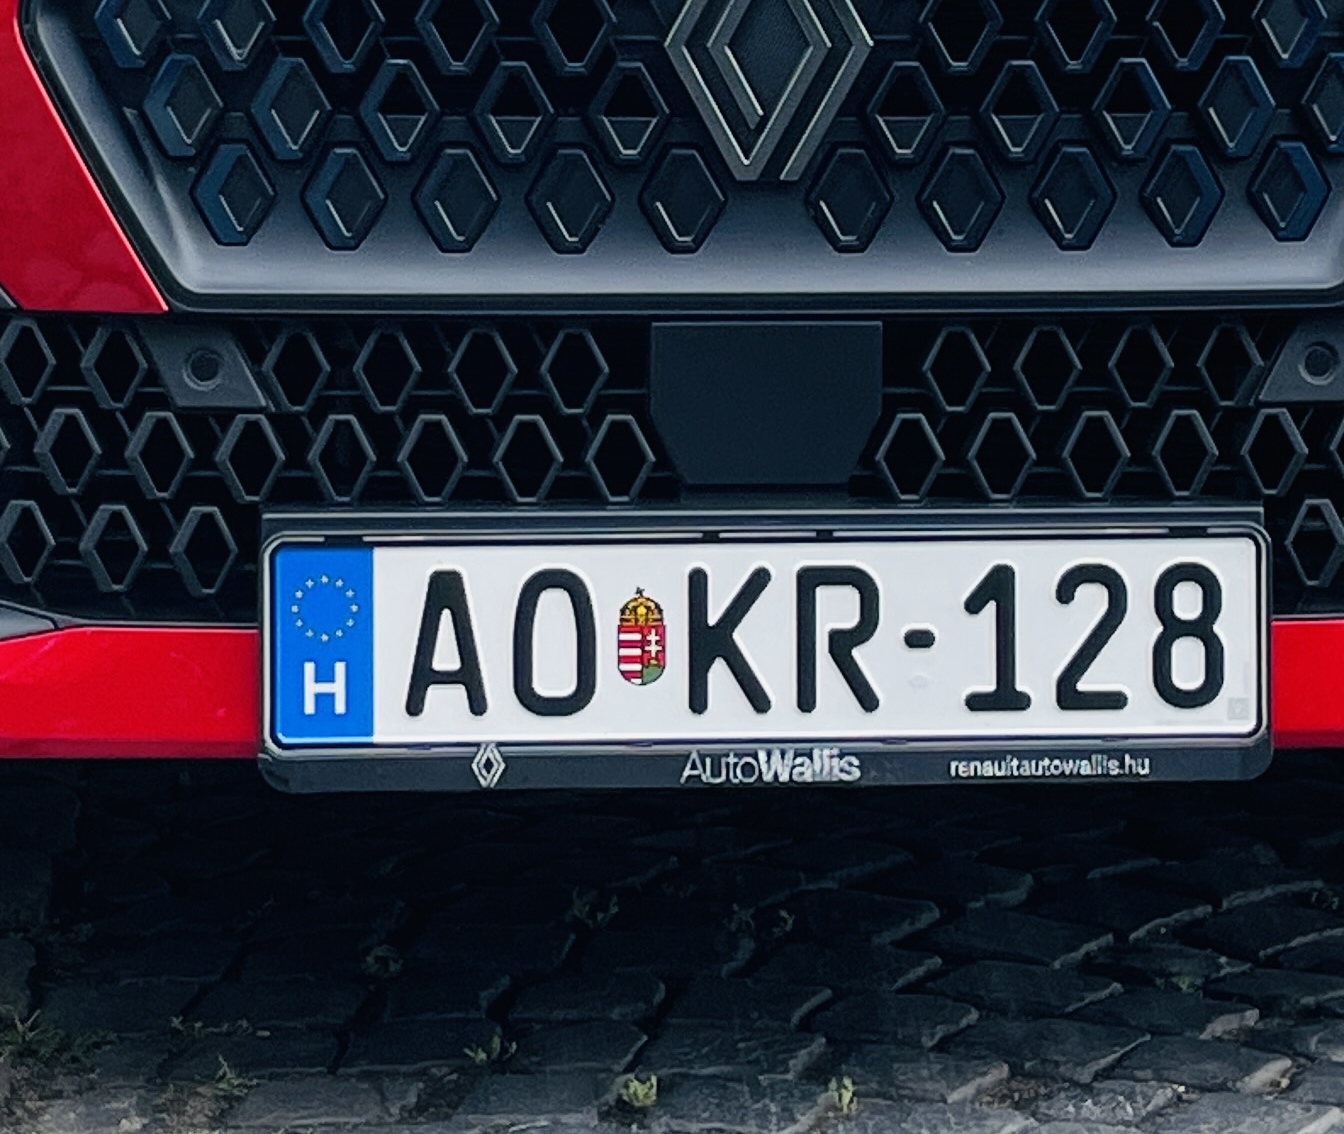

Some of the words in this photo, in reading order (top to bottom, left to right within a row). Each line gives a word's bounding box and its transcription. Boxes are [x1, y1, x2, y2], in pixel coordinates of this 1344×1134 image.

[405, 568, 598, 716] AO
[687, 563, 1225, 714] KR-128
[303, 661, 347, 715] H
[679, 747, 862, 784] AutoWallis
[949, 752, 1150, 777] renaultautowallis.hu
